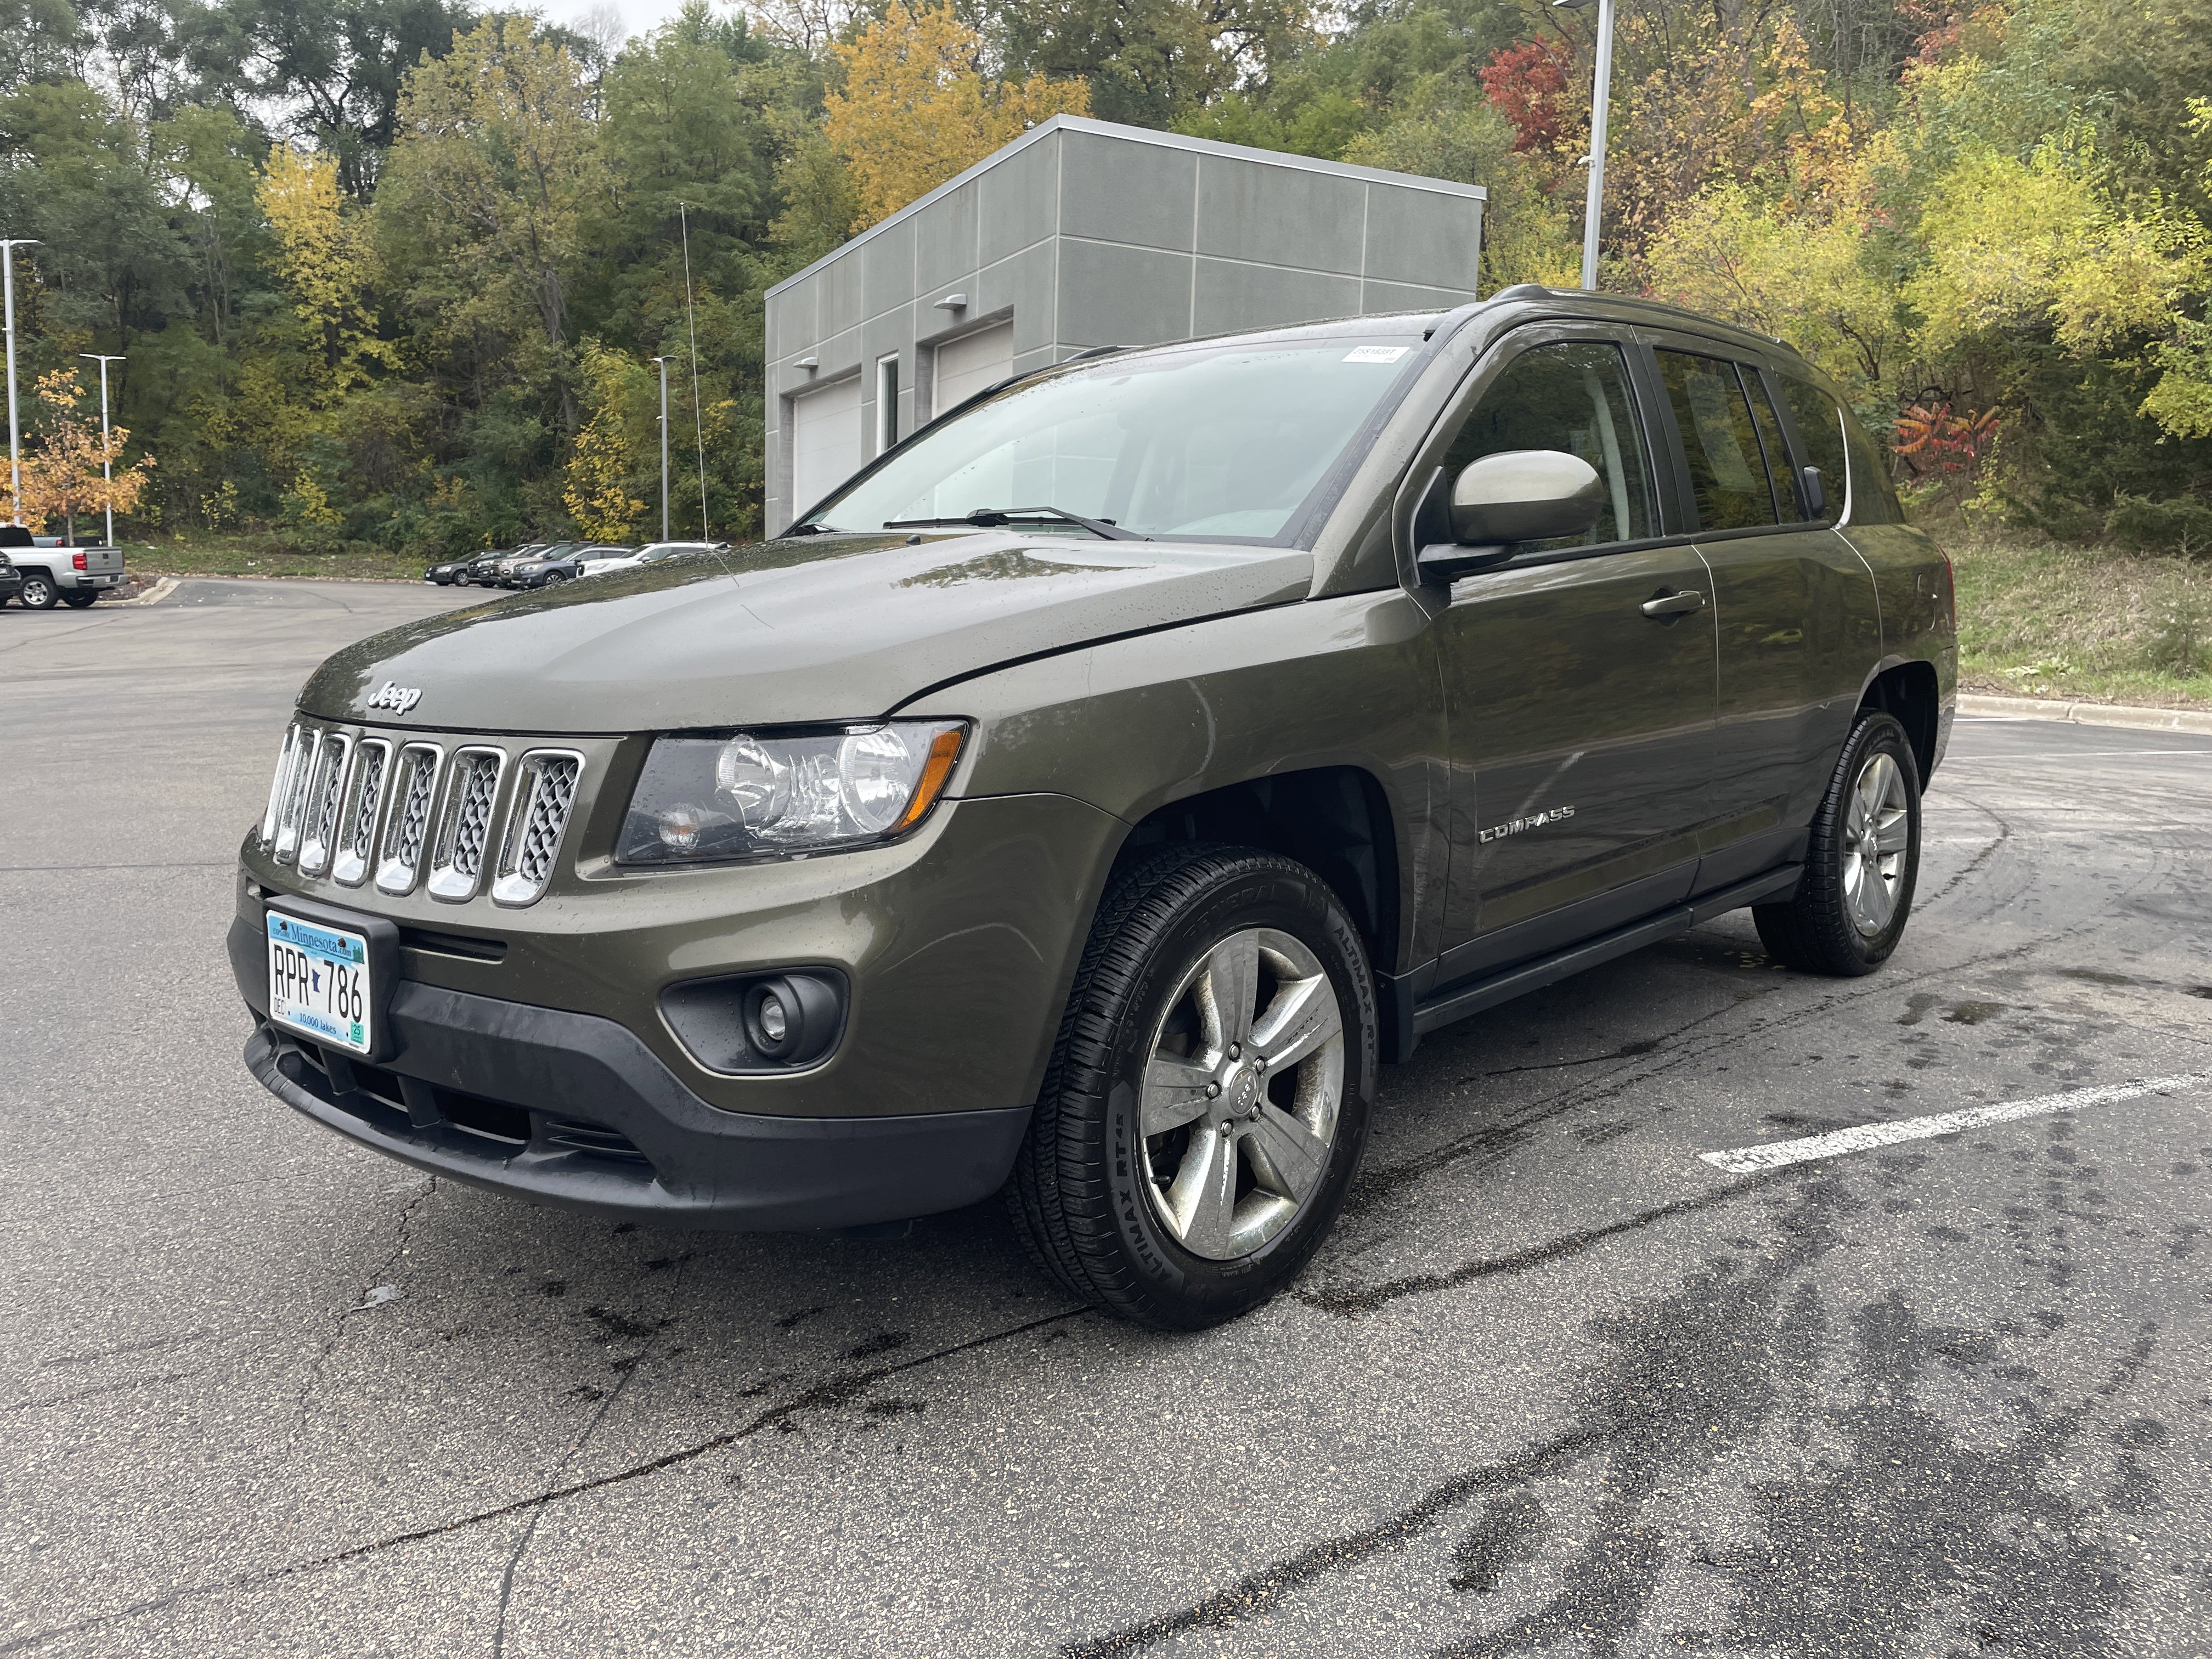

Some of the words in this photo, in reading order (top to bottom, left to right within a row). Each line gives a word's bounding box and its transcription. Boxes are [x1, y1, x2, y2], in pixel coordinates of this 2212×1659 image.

[368, 680, 422, 716] Jeep
[1479, 805, 1575, 844] COMPASS
[274, 944, 309, 1006] RPR
[324, 959, 362, 1024] 786
[1333, 926, 1372, 1014] ALTIMAX
[274, 997, 285, 1015] DEC
[300, 1013, 319, 1028] 10,000
[320, 1019, 337, 1035] lakes
[353, 1023, 360, 1036] 25
[1119, 1189, 1172, 1283] ALTIMAX
